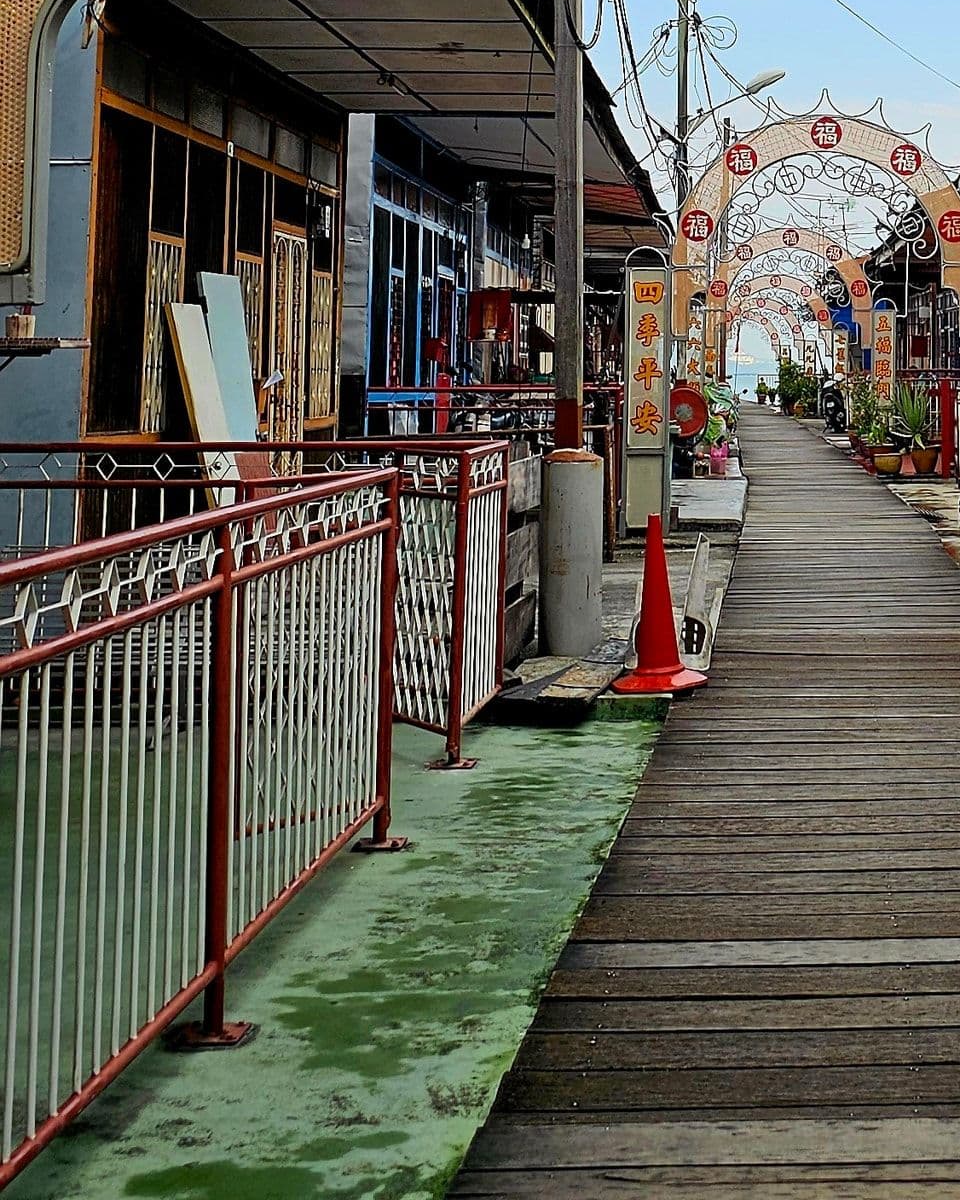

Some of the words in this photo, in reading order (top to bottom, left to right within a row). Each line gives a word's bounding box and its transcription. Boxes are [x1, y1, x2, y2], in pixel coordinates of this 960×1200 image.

[814, 120, 840, 147] 福
[728, 147, 755, 174] 福
[892, 147, 919, 174] 福
[684, 213, 710, 239] 福
[631, 280, 664, 436] 四季平安
[874, 315, 893, 402] 五福臨門
